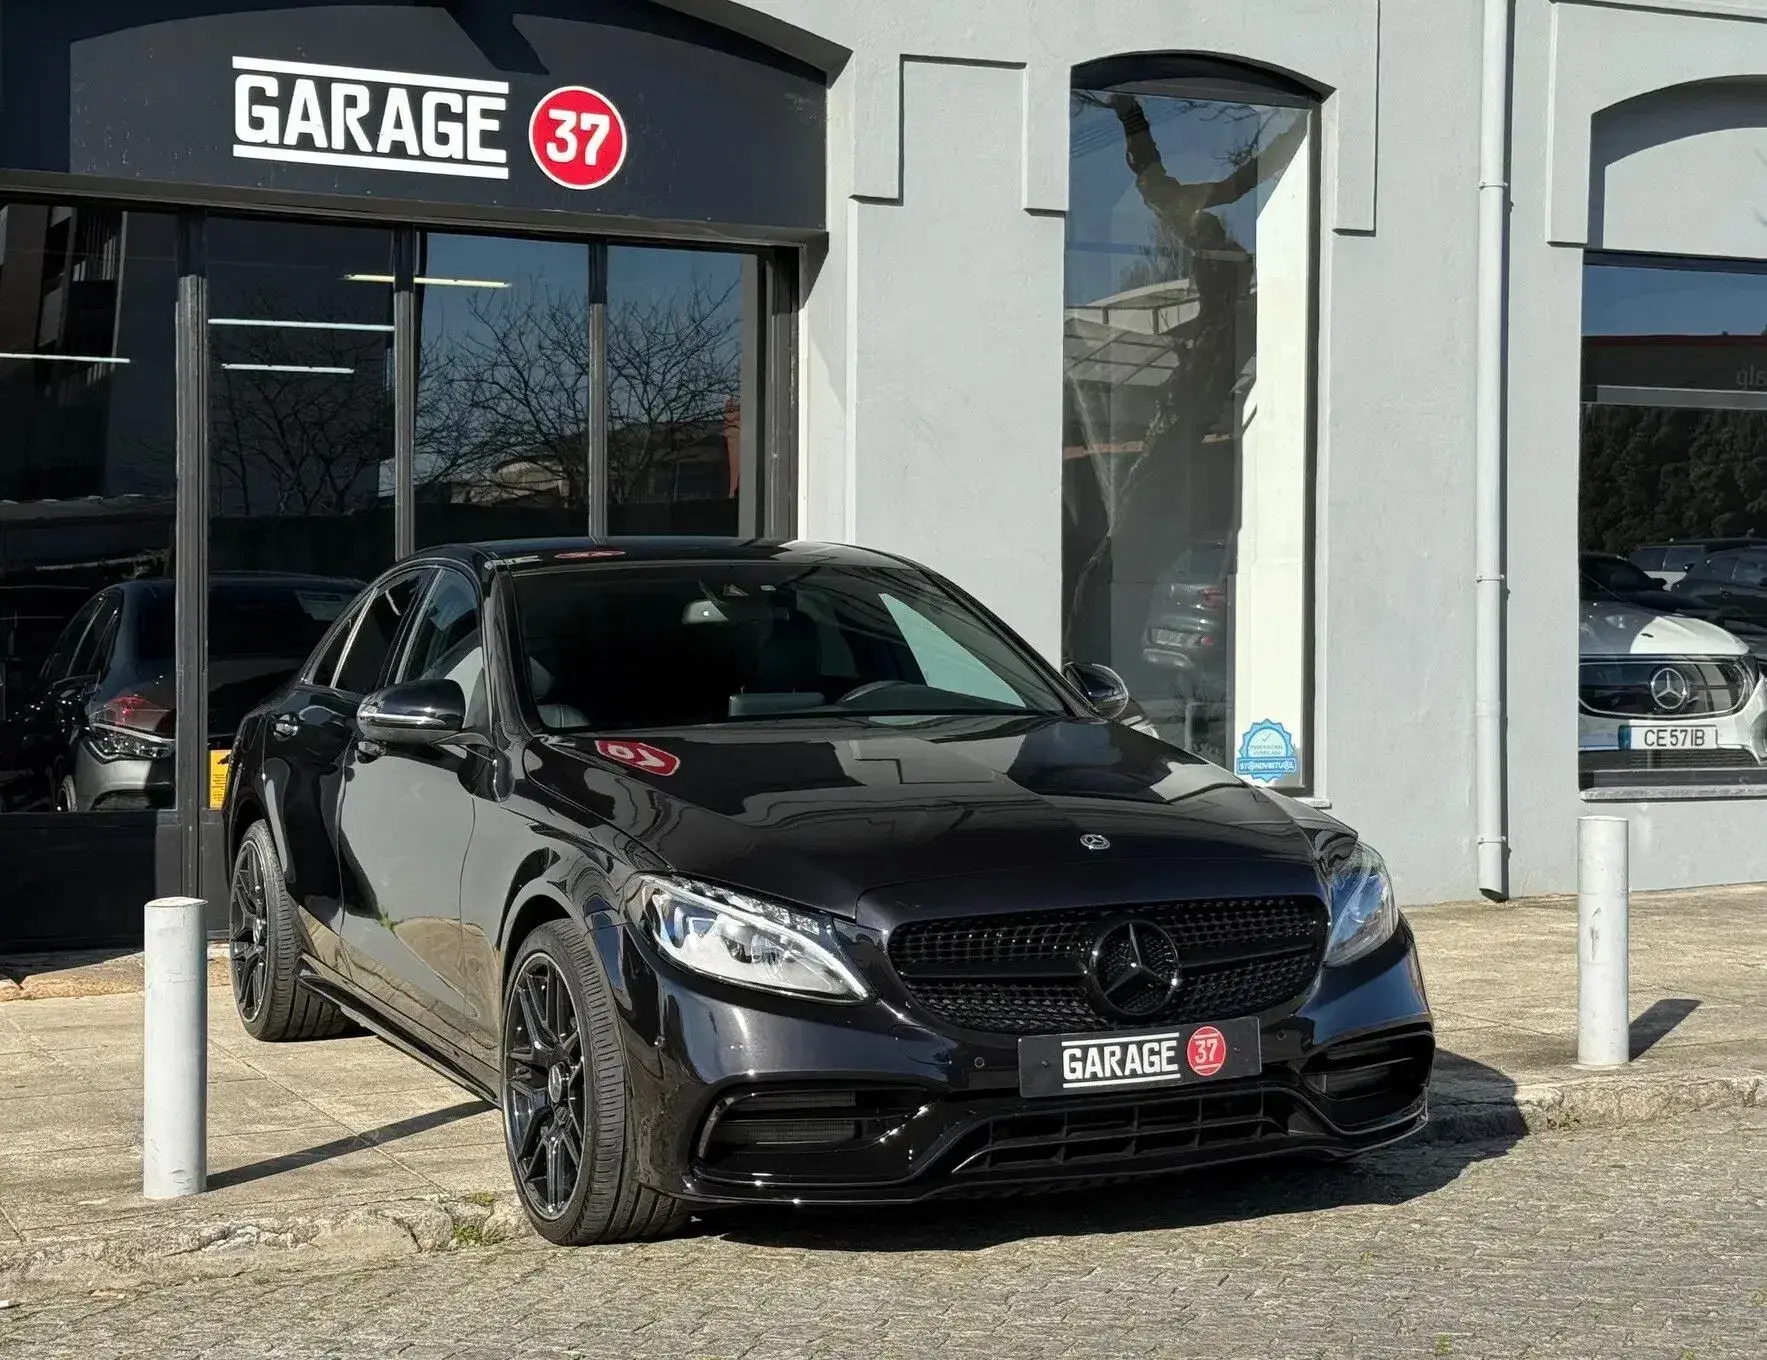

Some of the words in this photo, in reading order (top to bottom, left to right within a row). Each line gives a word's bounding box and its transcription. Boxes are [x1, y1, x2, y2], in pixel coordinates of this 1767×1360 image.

[235, 74, 507, 164] GARAGE
[546, 108, 611, 166] 37
[1062, 1040, 1178, 1080] GARAGE
[1194, 1038, 1218, 1064] 37
